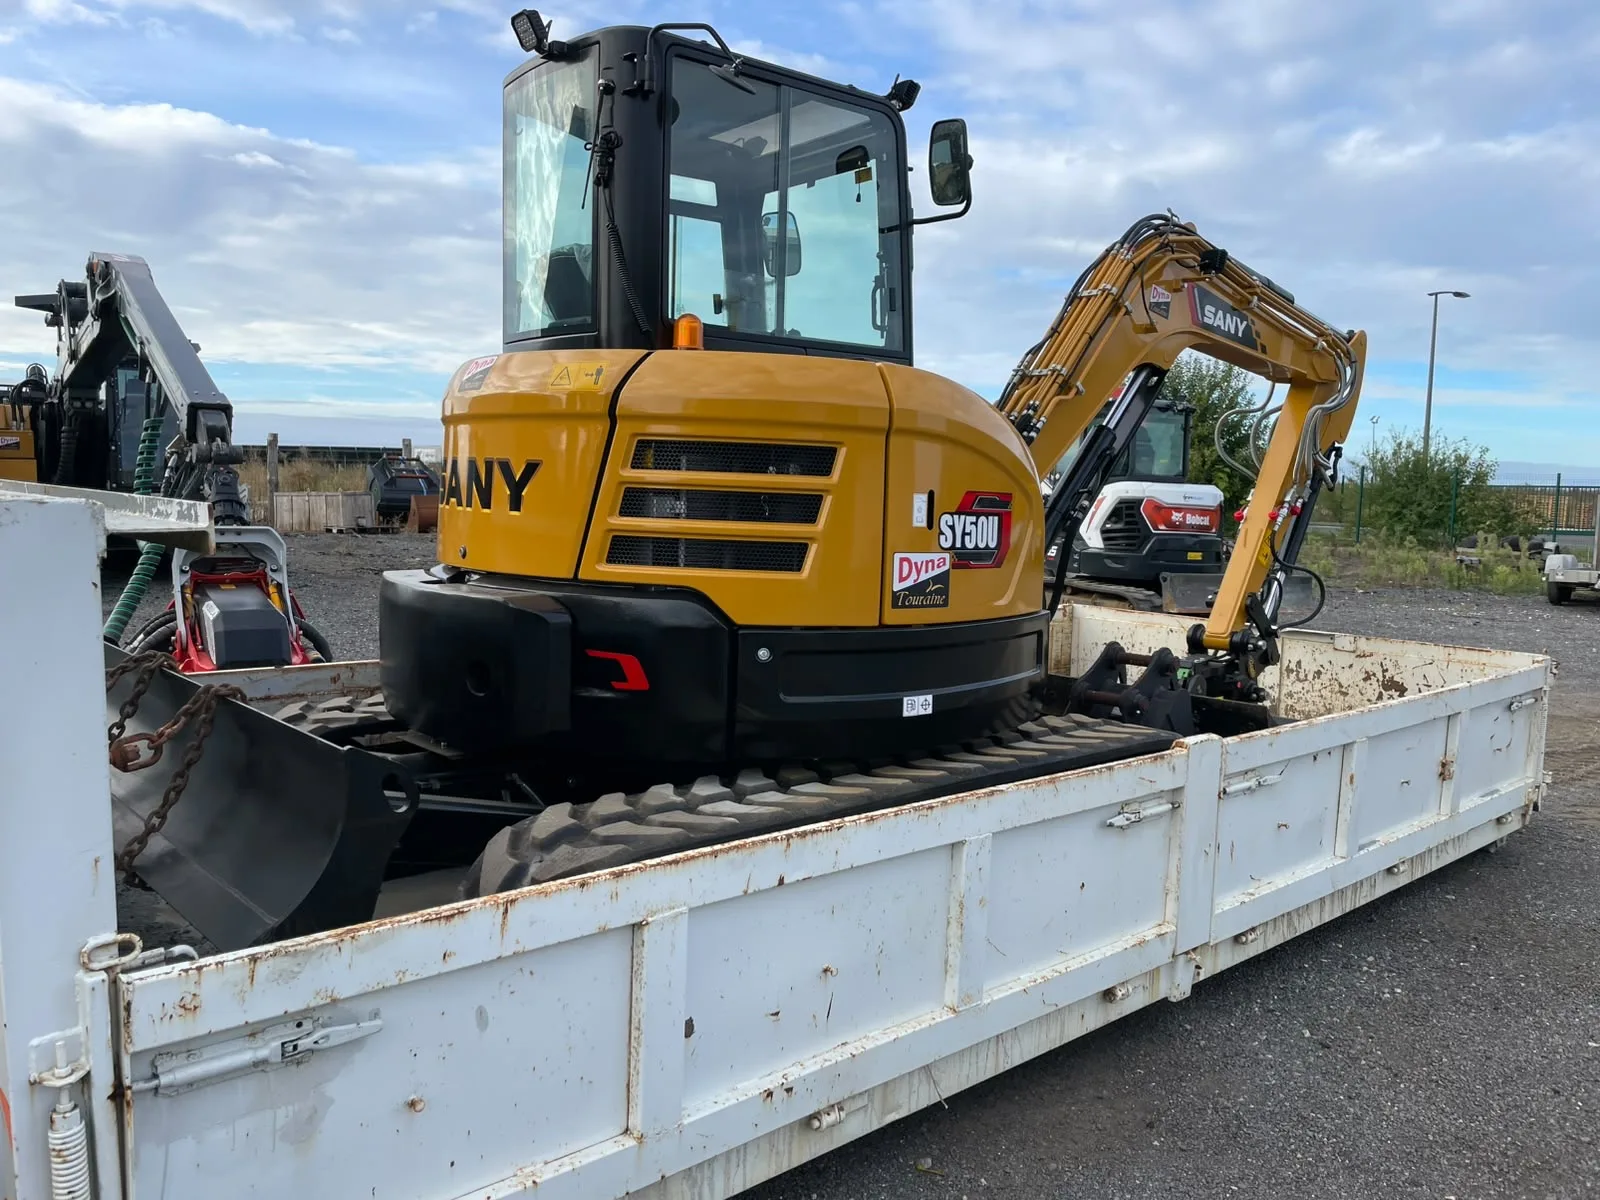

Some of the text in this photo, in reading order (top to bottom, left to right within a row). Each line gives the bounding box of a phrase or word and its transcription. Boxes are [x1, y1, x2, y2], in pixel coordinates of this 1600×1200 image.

[1152, 286, 1170, 301] Dyna
[1204, 304, 1247, 337] SANY
[1185, 513, 1210, 526] Bobcat
[940, 513, 999, 549] SY50U
[898, 556, 947, 584] Dyna
[896, 591, 946, 606] Touraine
